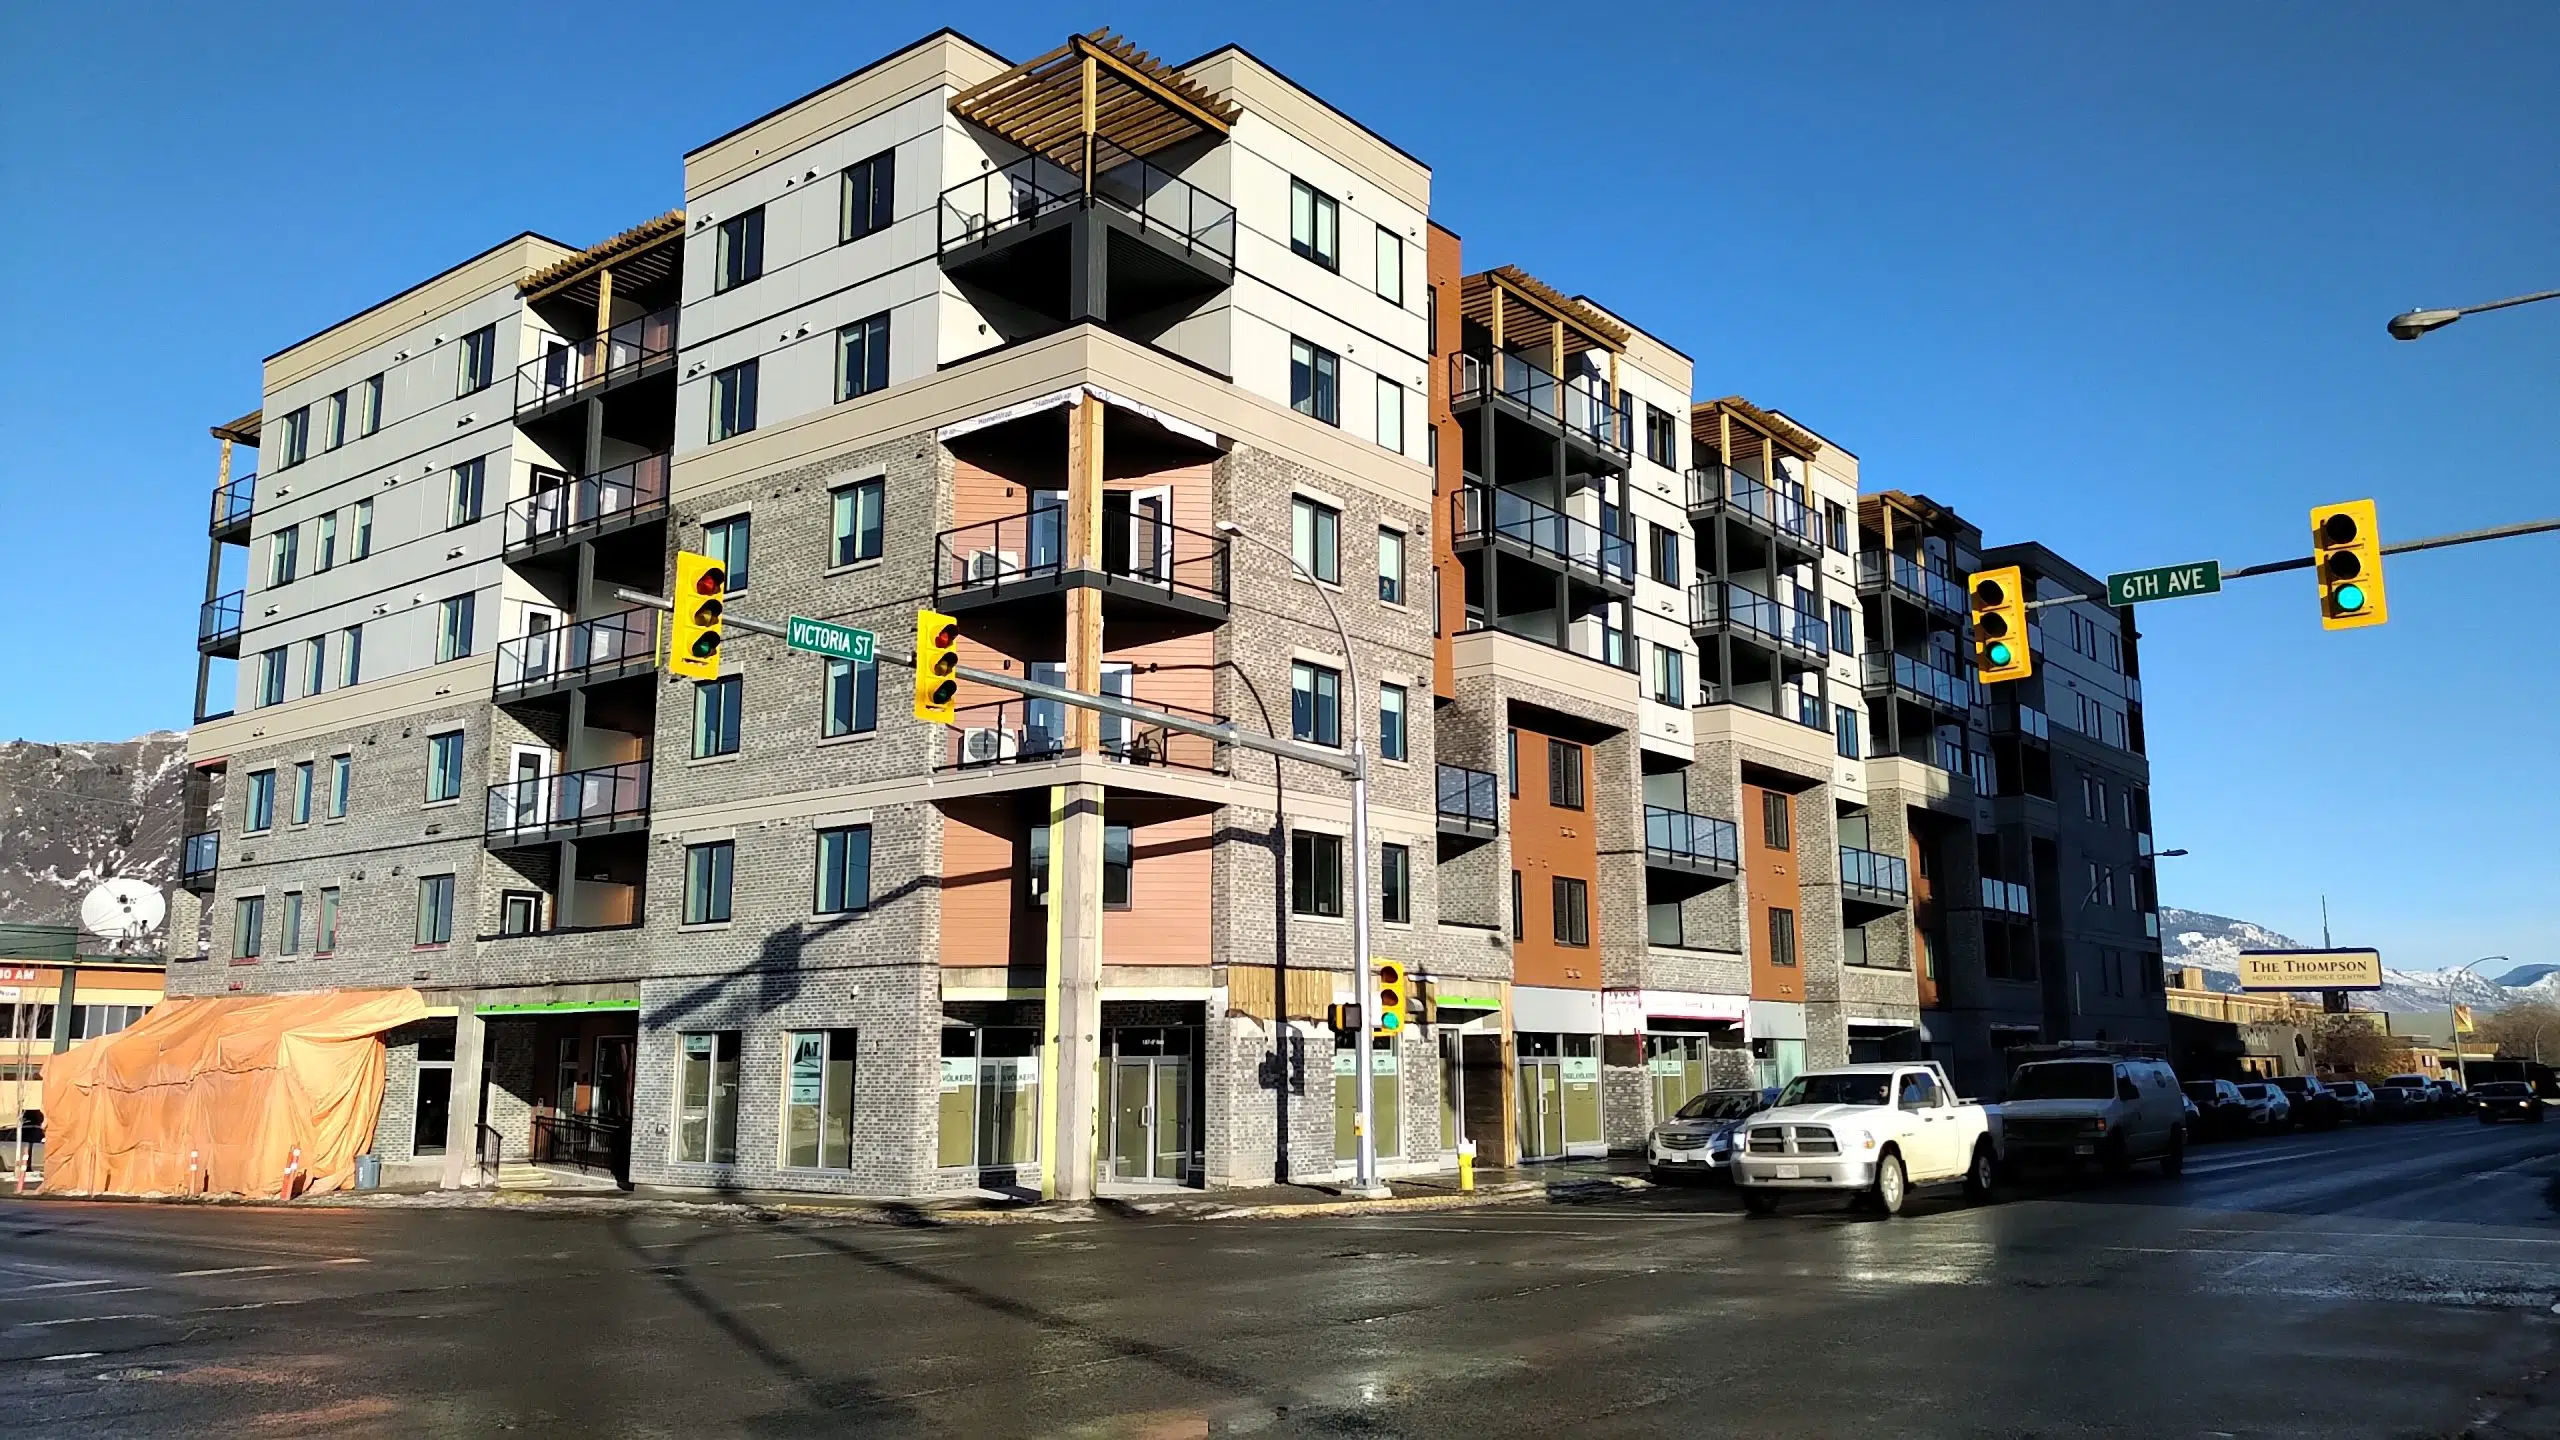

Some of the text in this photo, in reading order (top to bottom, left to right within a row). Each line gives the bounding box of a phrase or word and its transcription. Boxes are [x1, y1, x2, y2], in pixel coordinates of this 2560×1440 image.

[2122, 568, 2206, 599] 6TH AVE
[793, 621, 871, 656] VICTORIA ST
[15, 969, 35, 980] AM
